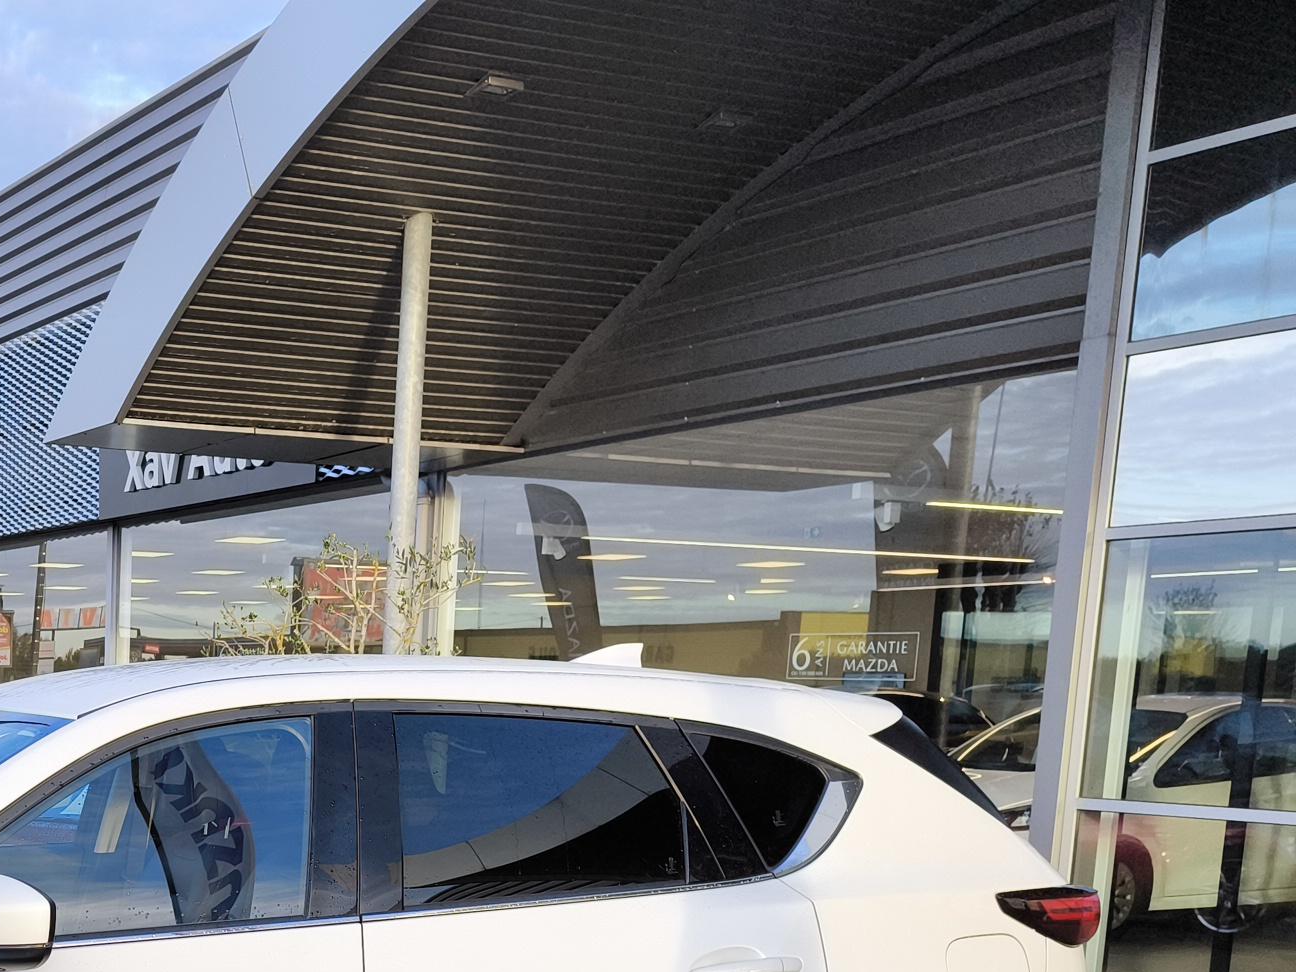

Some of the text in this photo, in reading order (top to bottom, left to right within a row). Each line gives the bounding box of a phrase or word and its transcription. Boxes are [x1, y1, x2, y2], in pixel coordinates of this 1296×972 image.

[124, 449, 181, 492] Xav
[791, 636, 909, 671] 6 ANS GARANTIE
[842, 658, 899, 673] MAZDA
